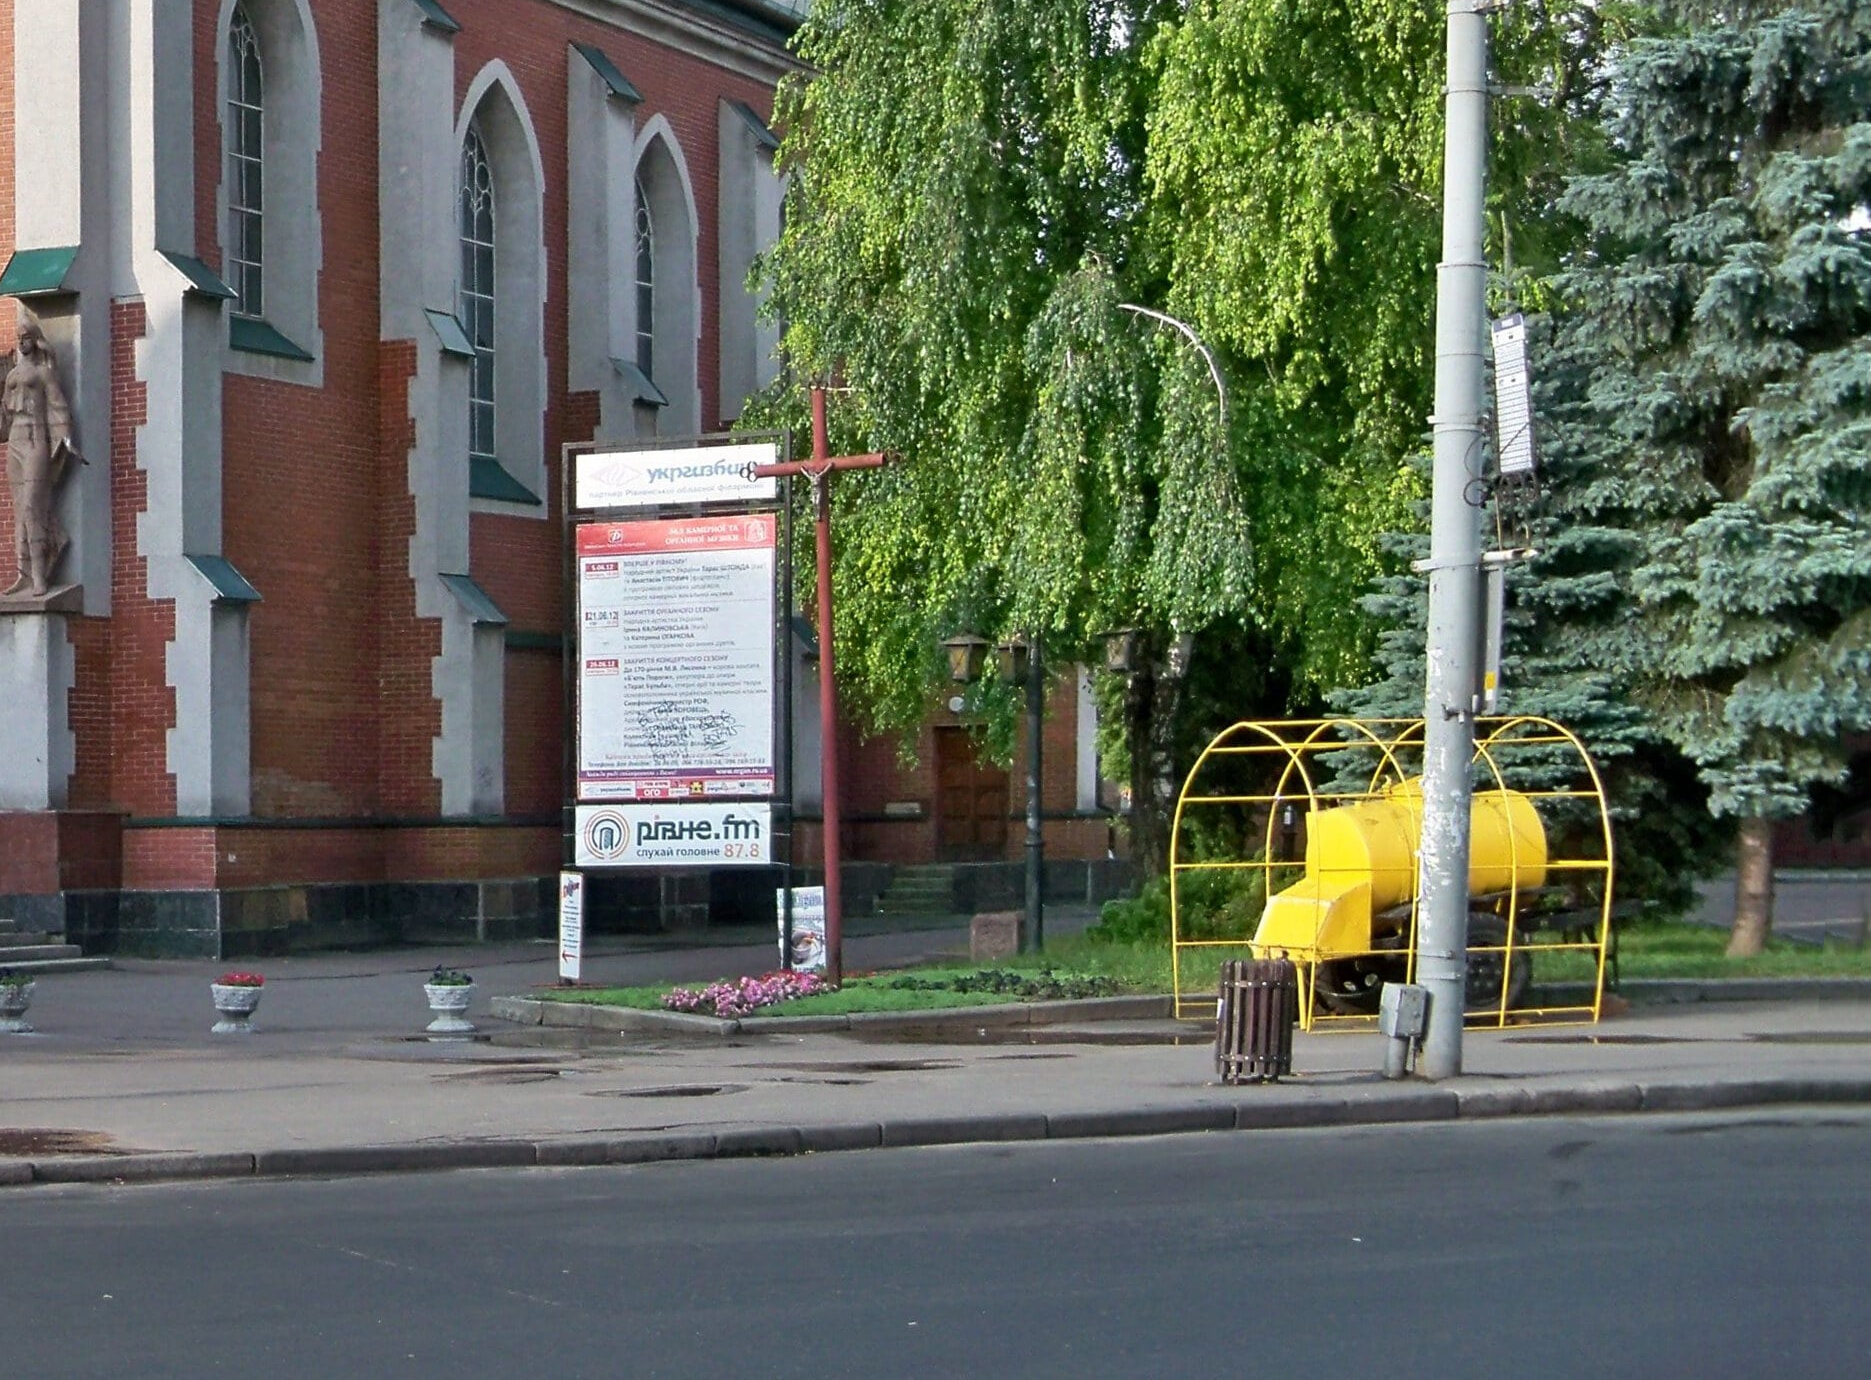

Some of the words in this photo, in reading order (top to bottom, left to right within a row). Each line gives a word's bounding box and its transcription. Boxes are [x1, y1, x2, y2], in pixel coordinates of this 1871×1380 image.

[636, 846, 674, 859] слухай
[675, 848, 720, 857] головне
[723, 843, 760, 858] 87.8
